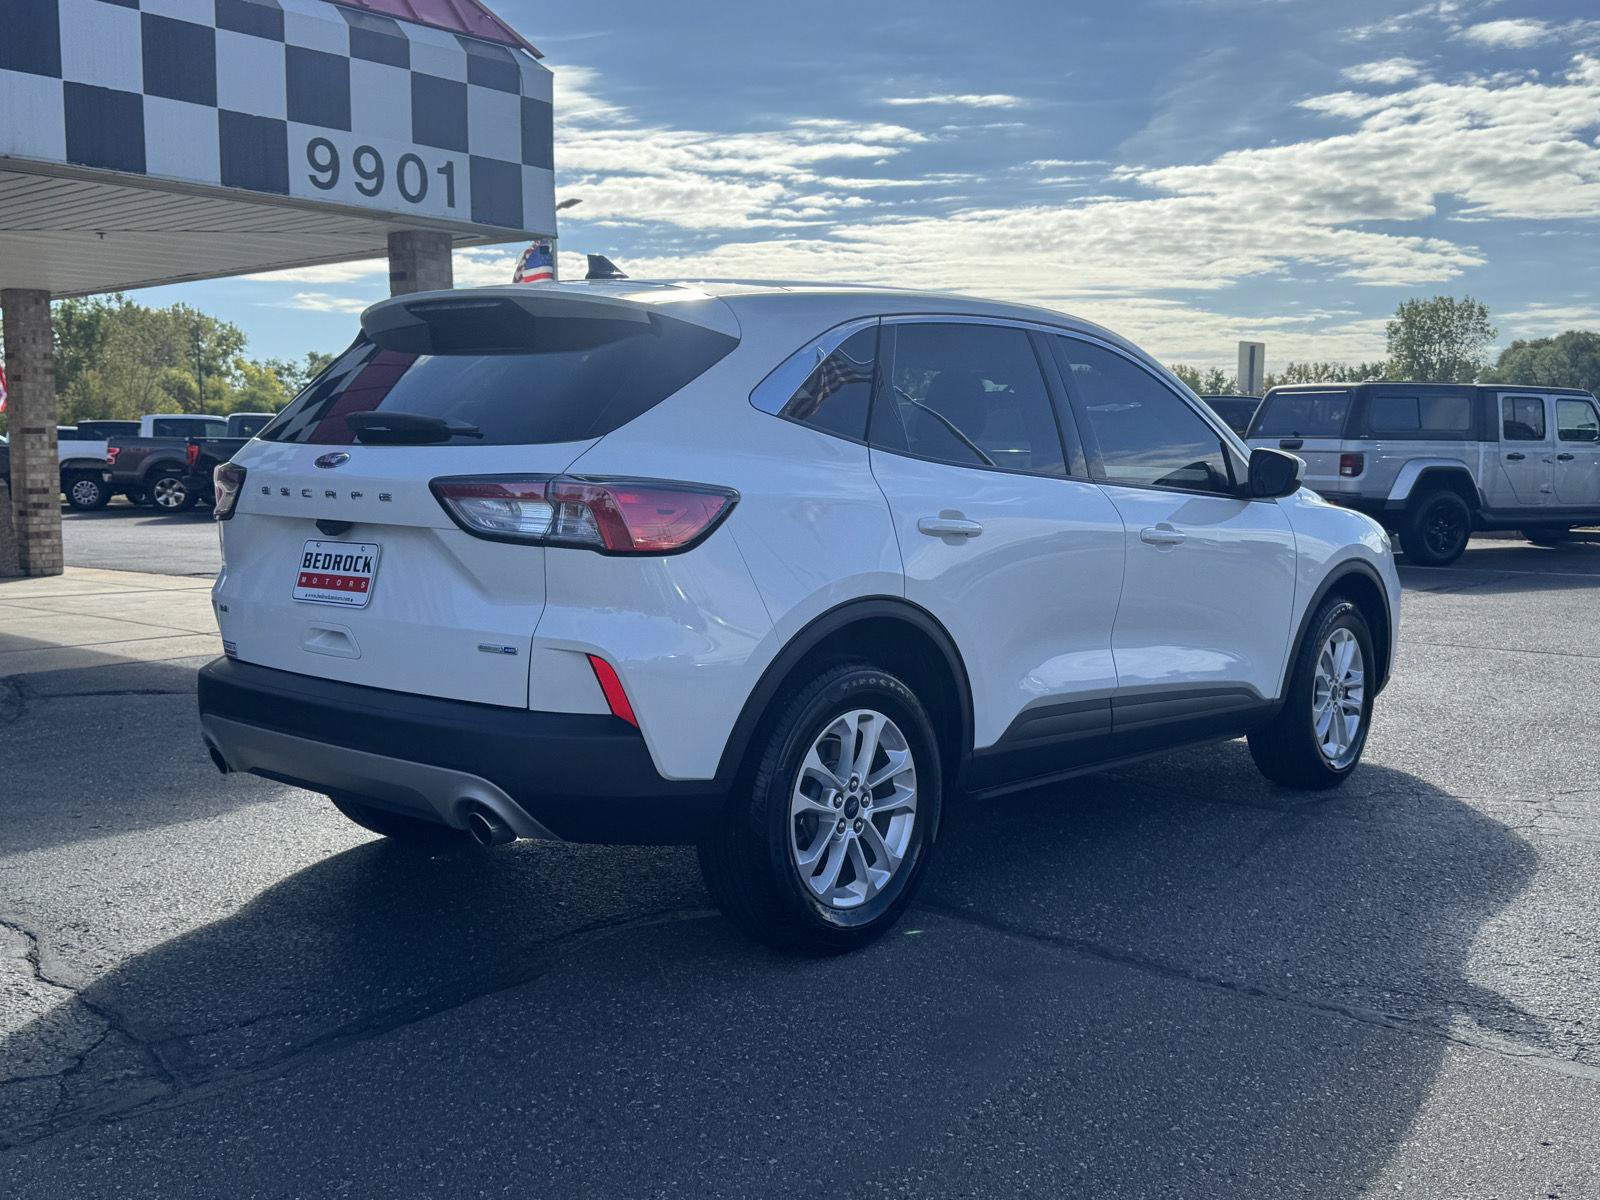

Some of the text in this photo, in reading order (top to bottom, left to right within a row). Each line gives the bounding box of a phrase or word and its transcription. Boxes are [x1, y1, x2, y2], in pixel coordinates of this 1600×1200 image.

[306, 136, 455, 208] 9901
[261, 486, 393, 502] ESCAPE
[302, 552, 373, 573] BEDROCK
[301, 576, 366, 589] MOTORS
